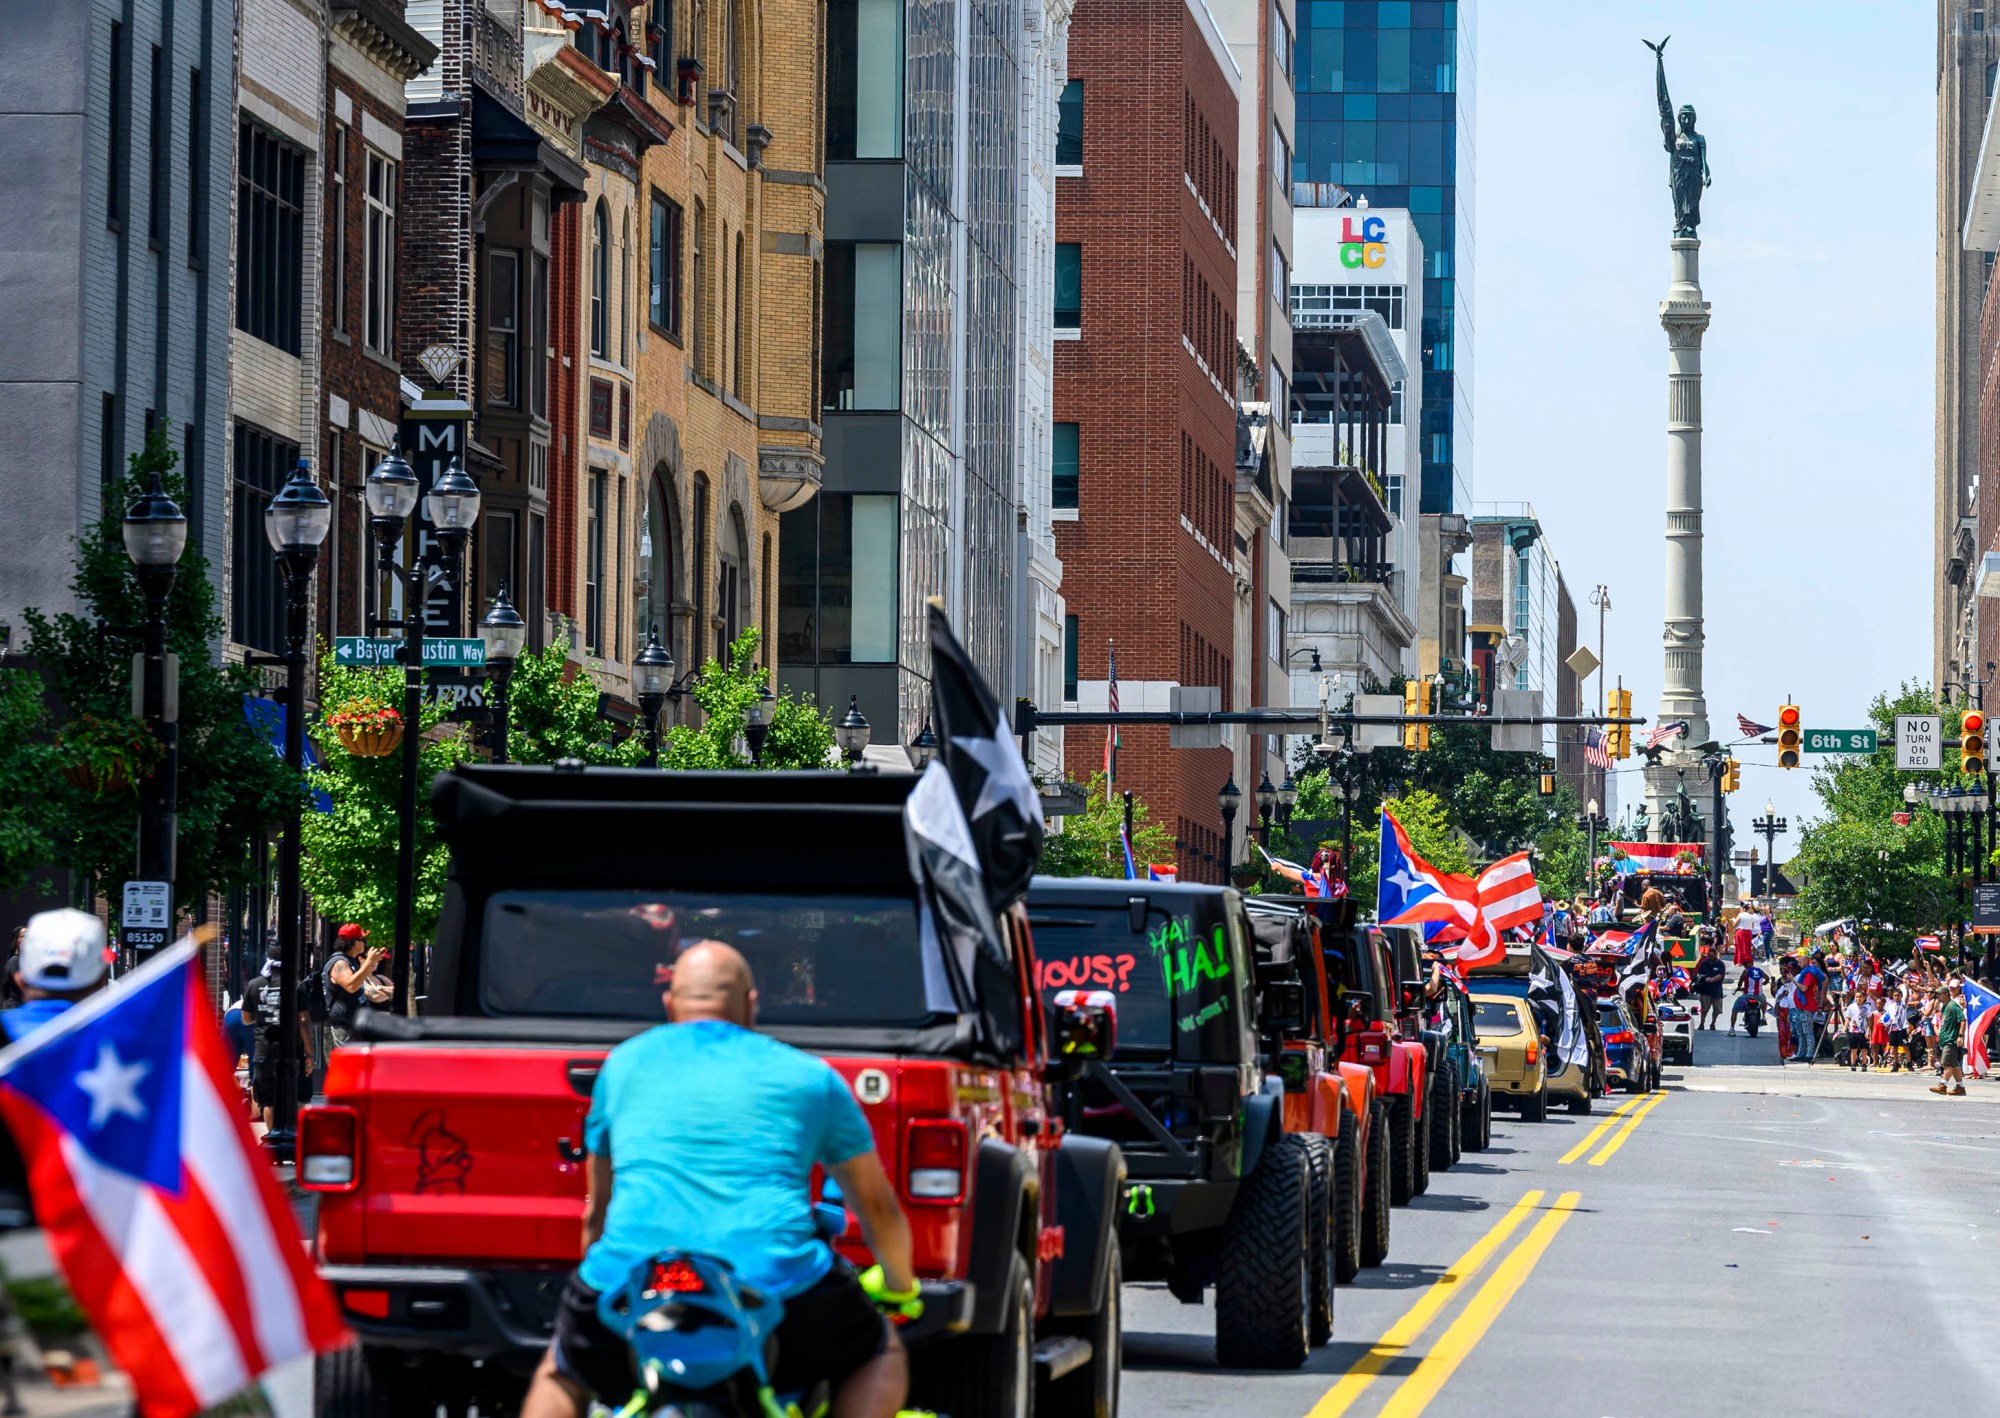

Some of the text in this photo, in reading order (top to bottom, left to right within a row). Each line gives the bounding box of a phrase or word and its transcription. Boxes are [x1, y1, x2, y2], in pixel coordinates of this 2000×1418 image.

[419, 424, 455, 638] MIHAE
[356, 639, 484, 663] Bayar ustin Way
[1907, 721, 1930, 733] NO
[1811, 734, 1870, 748] 6th St
[1905, 734, 1932, 743] TURN
[1911, 746, 1926, 754] ON
[1909, 756, 1929, 765] RED
[127, 932, 163, 943] 85120
[1148, 918, 1190, 956] HA!
[1162, 926, 1230, 997] HA!
